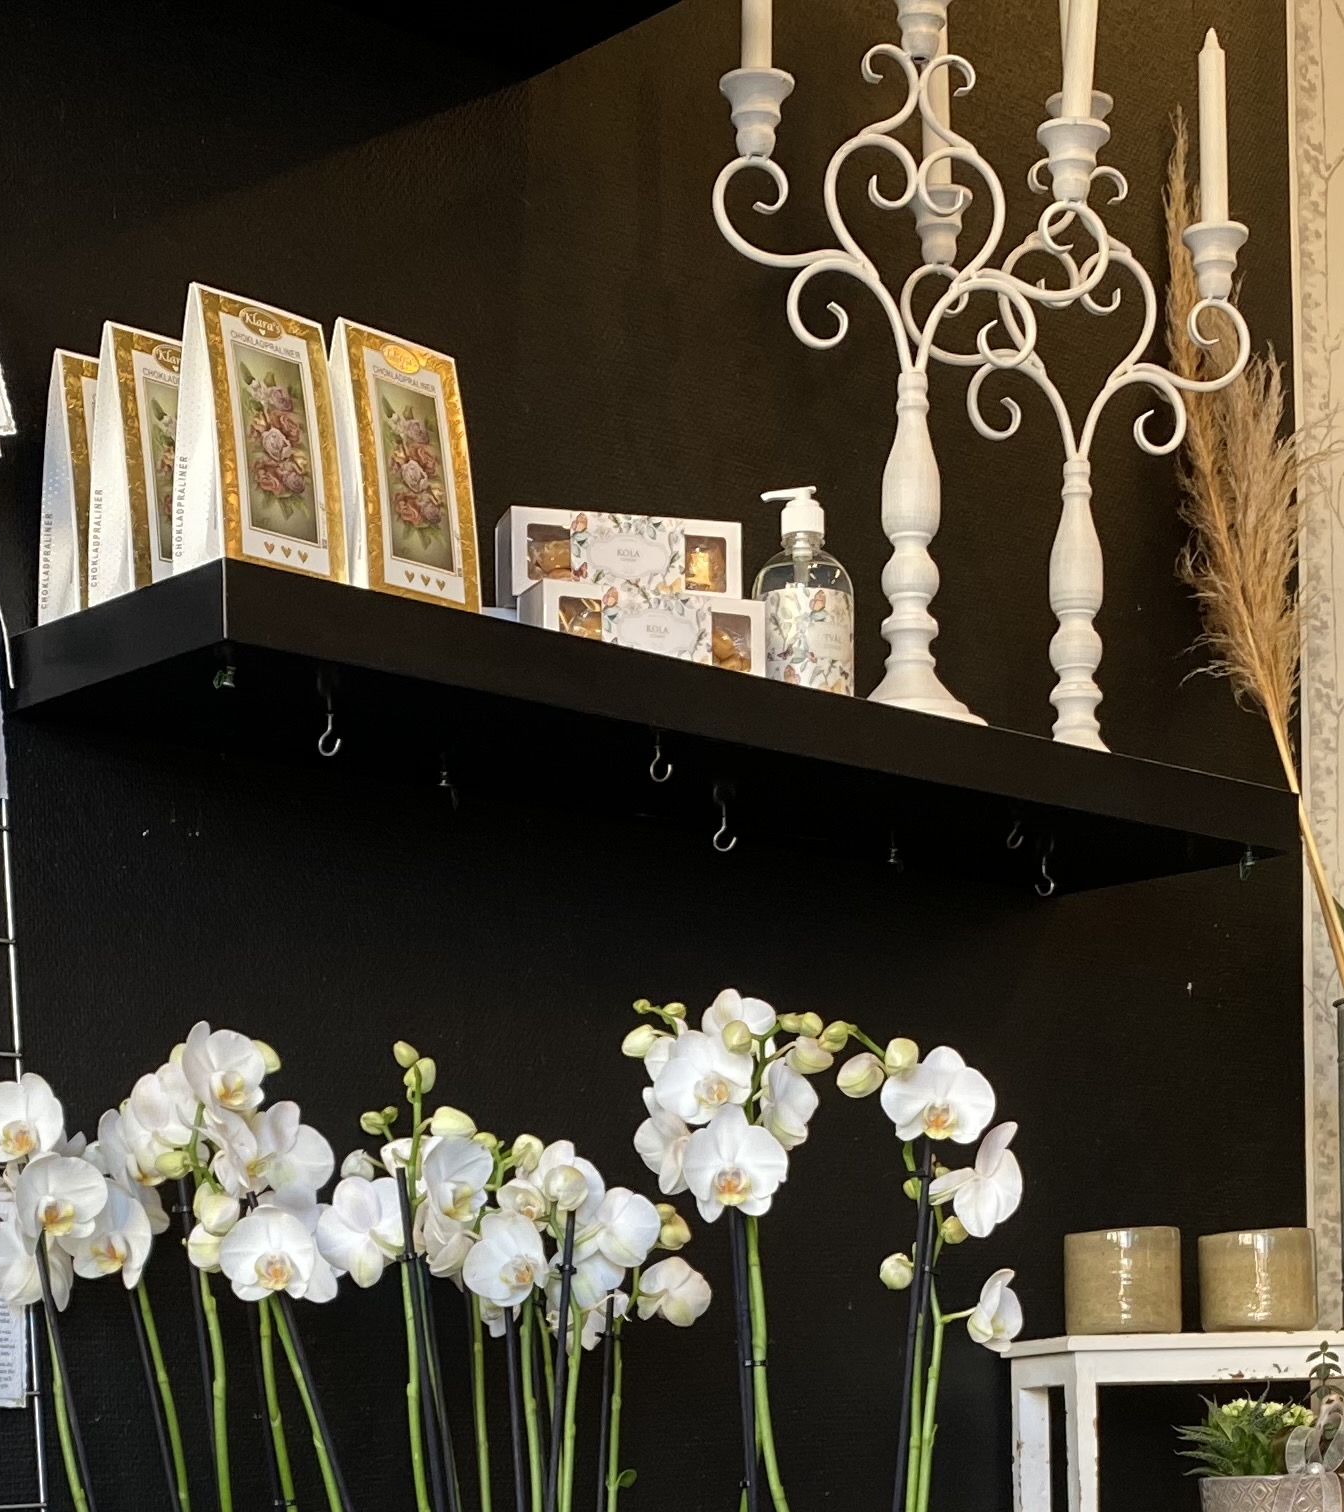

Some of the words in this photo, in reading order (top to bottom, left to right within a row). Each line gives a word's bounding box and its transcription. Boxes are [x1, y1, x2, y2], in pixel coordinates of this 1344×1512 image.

[244, 313, 281, 335] Klara's
[158, 349, 181, 365] Klar
[231, 330, 300, 359] CHOKLADPRALINER
[373, 365, 436, 393] CHOKLADPRALINER
[175, 456, 188, 557] CHOKLADPRALINER
[90, 489, 103, 587] CHOKLADPRALINER
[41, 513, 53, 609] CHOKLADPRALINER
[617, 548, 641, 558] KOLA
[646, 625, 669, 634] KOLA
